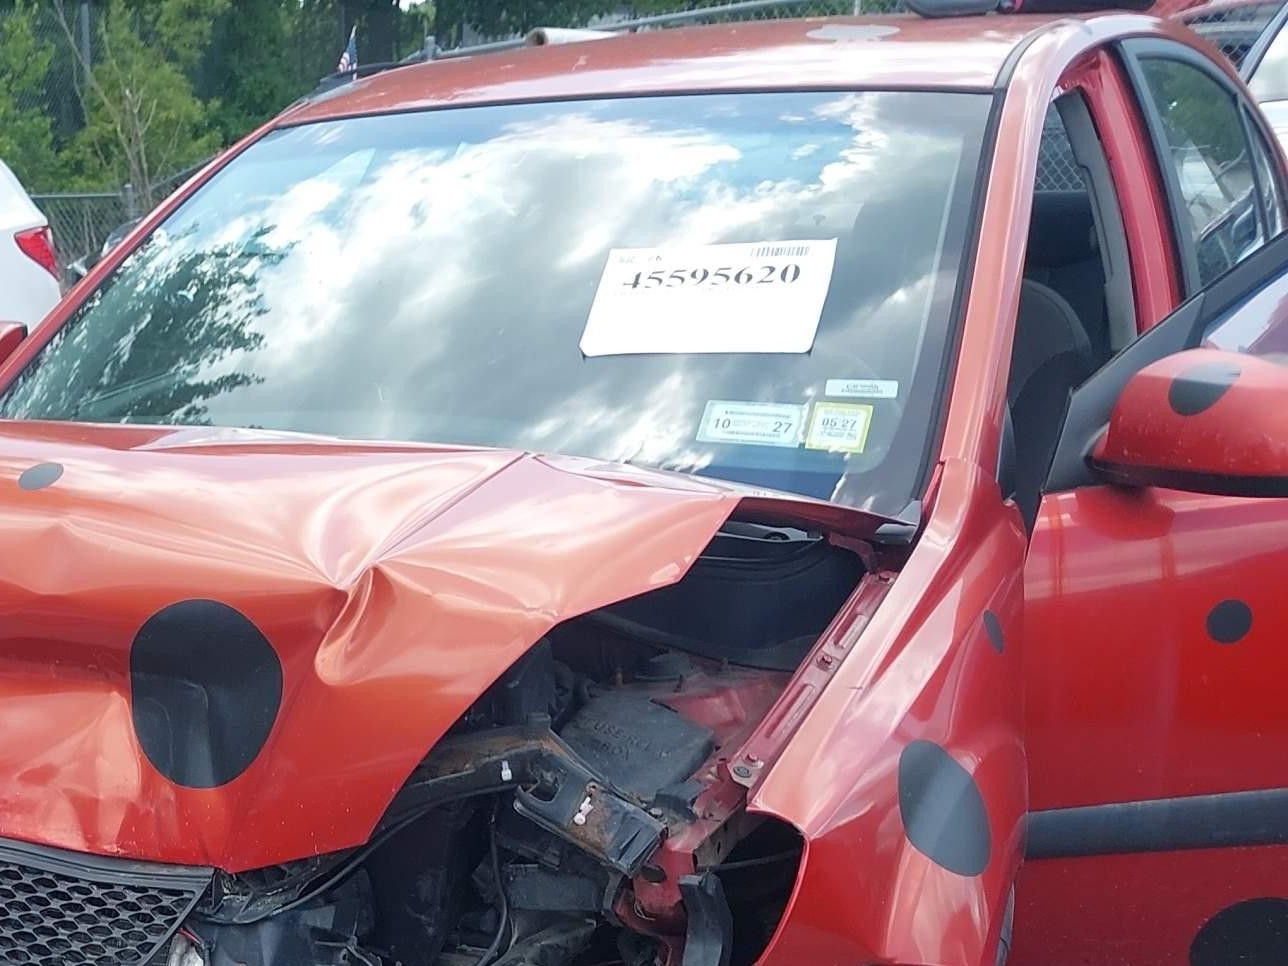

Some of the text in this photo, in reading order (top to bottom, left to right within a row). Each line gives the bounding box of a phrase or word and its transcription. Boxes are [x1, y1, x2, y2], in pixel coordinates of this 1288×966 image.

[622, 263, 801, 290] 45595620
[713, 417, 732, 429] 10
[772, 421, 793, 435] 27
